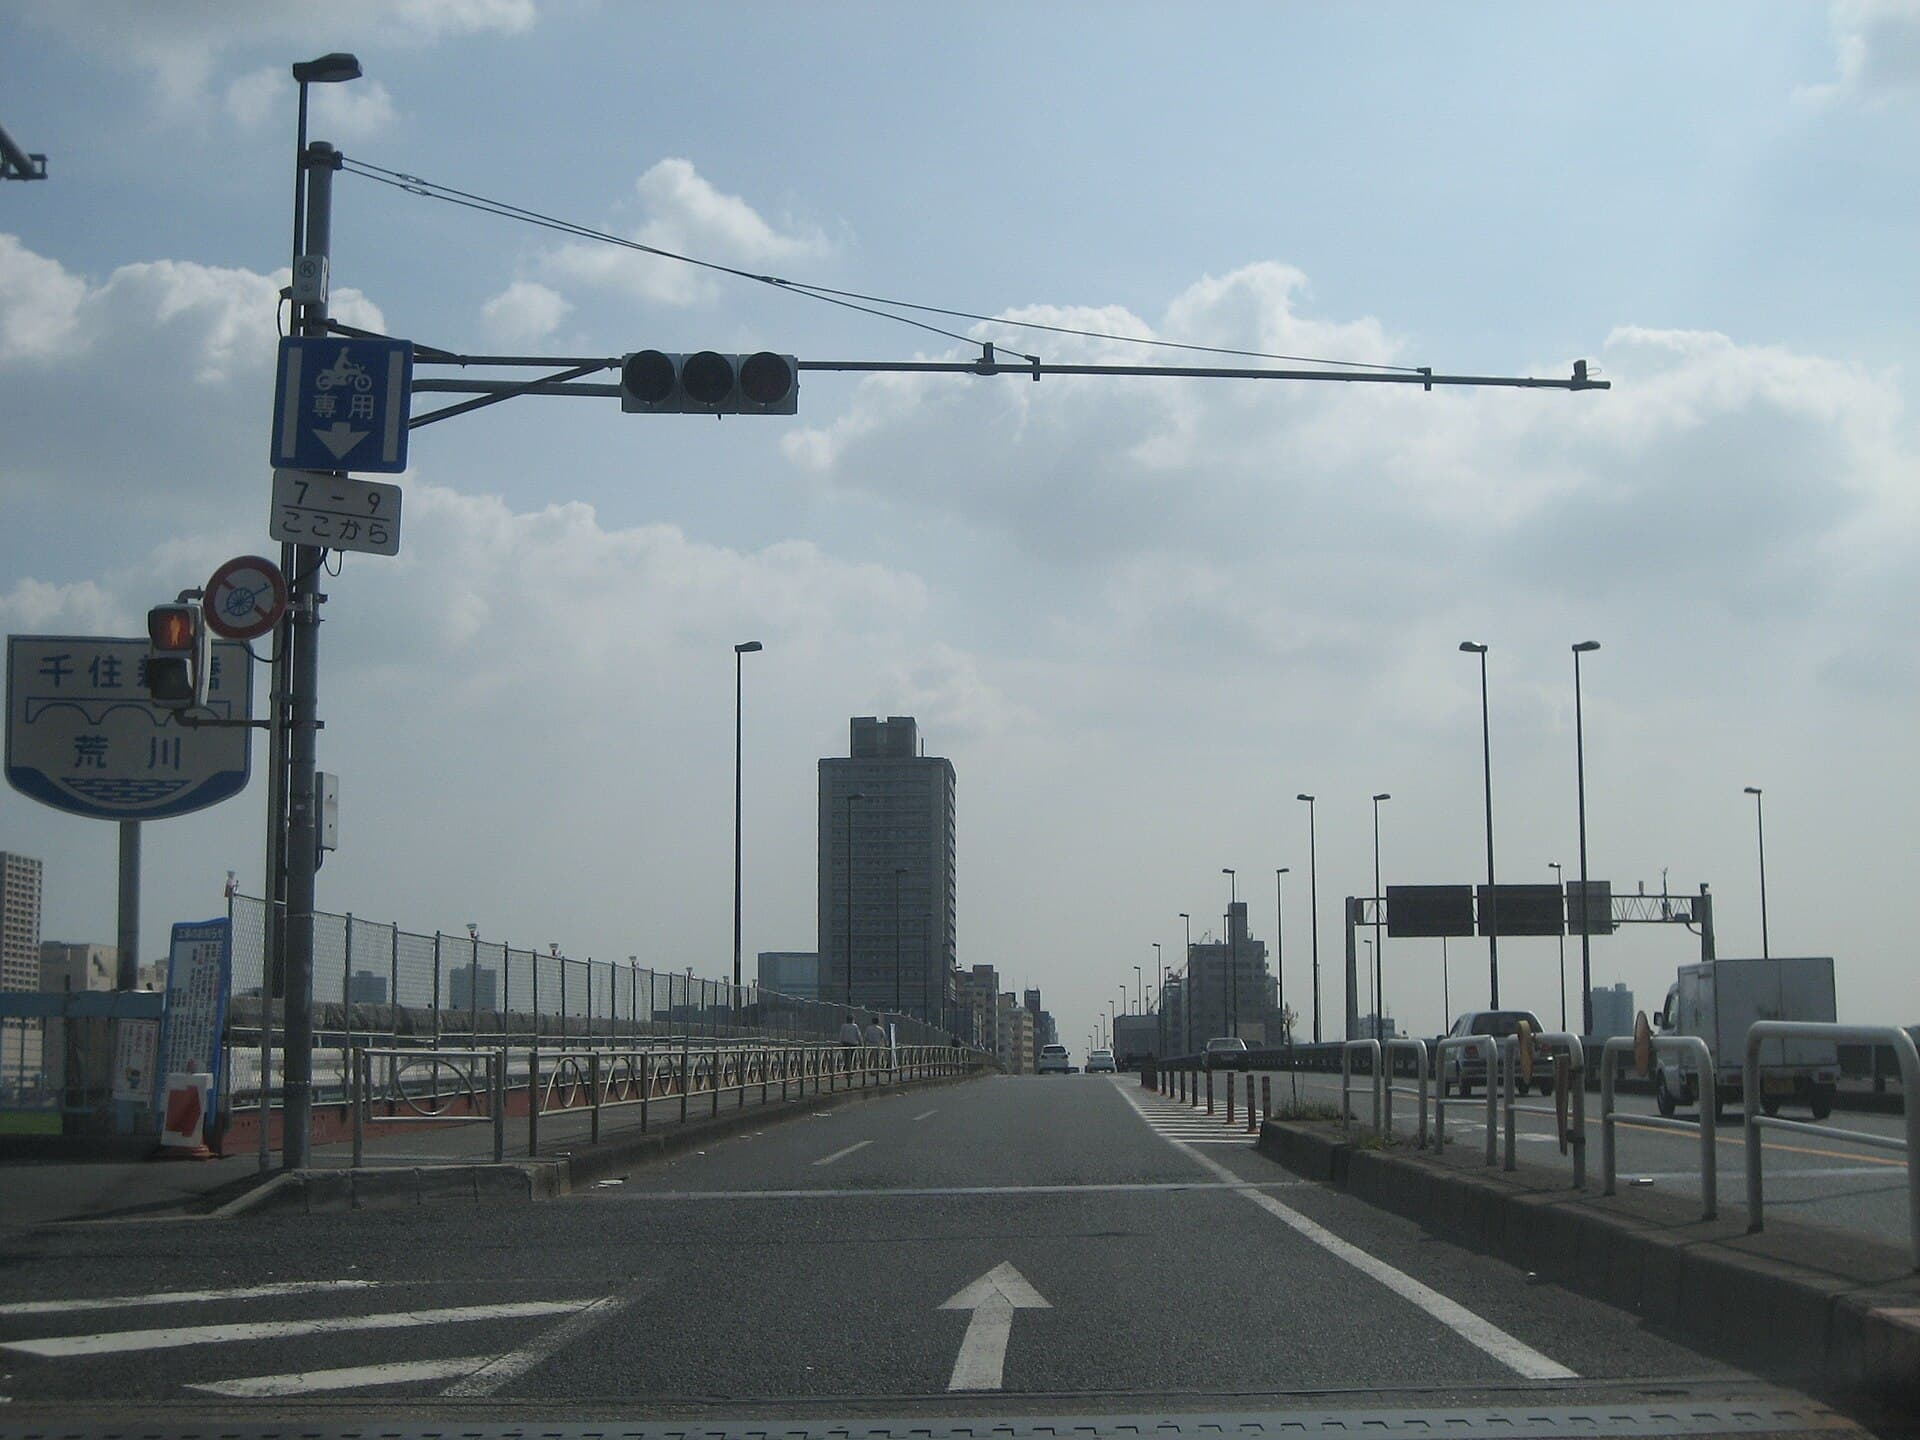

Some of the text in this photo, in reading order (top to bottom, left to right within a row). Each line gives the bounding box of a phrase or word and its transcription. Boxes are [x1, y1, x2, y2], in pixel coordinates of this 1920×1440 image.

[312, 394, 375, 420] 専用
[282, 511, 389, 546] ここから
[73, 735, 182, 770] 荒川
